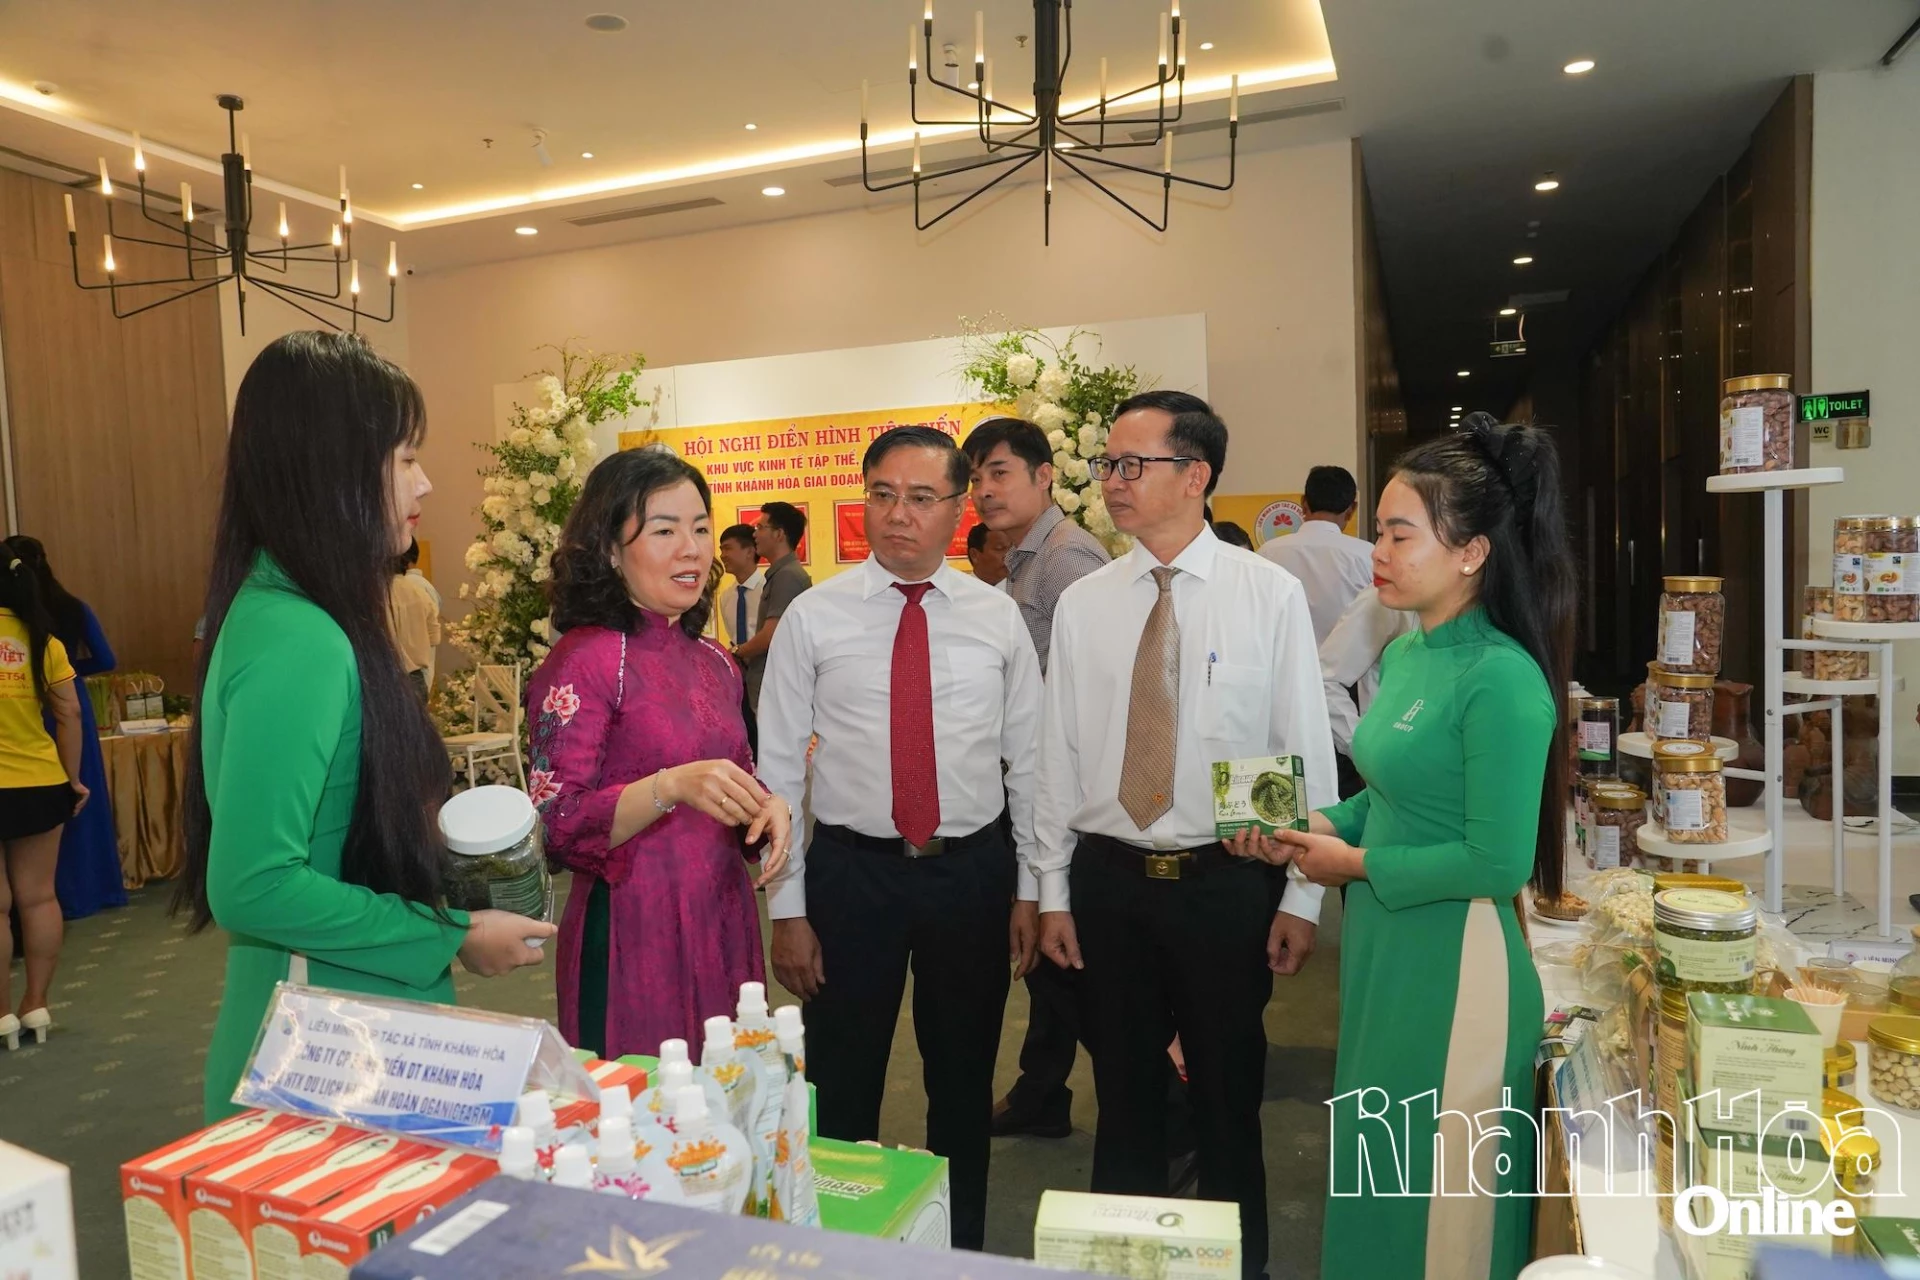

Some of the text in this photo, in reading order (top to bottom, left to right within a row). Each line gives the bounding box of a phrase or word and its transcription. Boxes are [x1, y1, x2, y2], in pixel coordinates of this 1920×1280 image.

[1829, 399, 1863, 411] TOILET
[684, 437, 713, 459] HỘI
[719, 435, 761, 454] NGHỊ
[767, 423, 809, 450] ĐIỂN
[816, 425, 861, 446] HÌNH
[1814, 426, 1829, 434] WC
[706, 463, 729, 475] KHU
[733, 461, 754, 476] VỰC
[759, 458, 786, 471] KINH
[807, 454, 829, 470] TẬP
[735, 477, 774, 492] KHÁNH
[777, 475, 800, 490] HÒA
[804, 474, 827, 488] GIAI
[443, 1040, 480, 1058] KHÁNH
[481, 1044, 506, 1062] HÒA
[323, 1046, 338, 1065] TY
[336, 1048, 352, 1069] CP
[421, 1063, 461, 1087] KHÁNH
[460, 1068, 484, 1091] HÒA
[303, 1075, 320, 1093] DU
[388, 1089, 420, 1112] HOÀN
